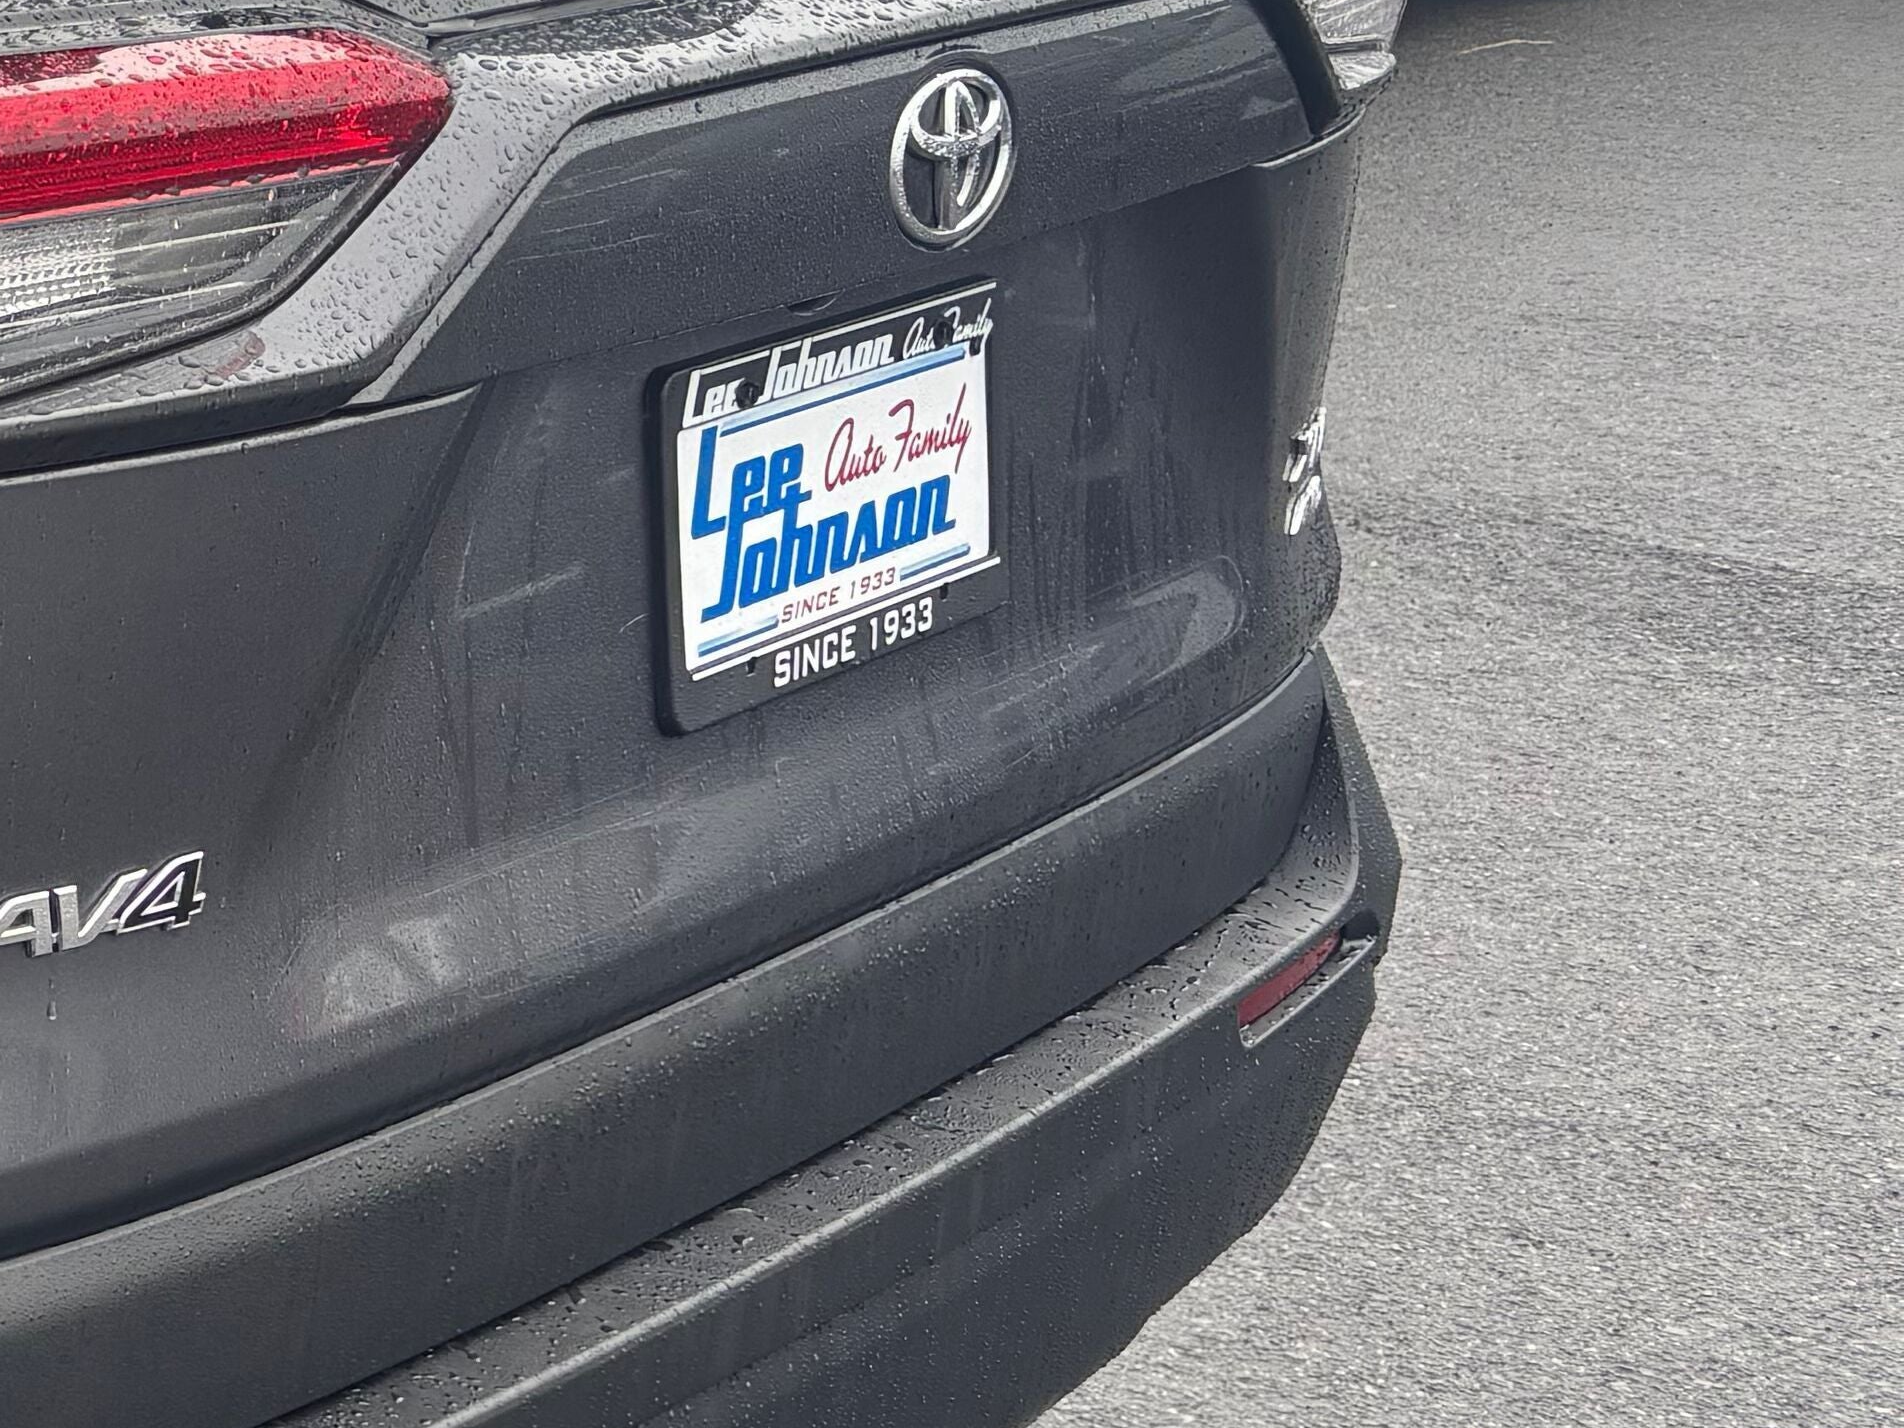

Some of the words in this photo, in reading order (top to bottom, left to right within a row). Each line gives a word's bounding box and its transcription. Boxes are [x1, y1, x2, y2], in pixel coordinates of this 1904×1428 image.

[755, 336, 894, 407] Johnson
[691, 425, 812, 538] Lee
[824, 417, 887, 492] Auto
[889, 383, 972, 473] Family
[700, 474, 956, 623] Johnson
[781, 586, 841, 623] SINCE
[850, 567, 896, 599] 1933
[773, 625, 857, 688] SINCE
[870, 596, 933, 652] 1933
